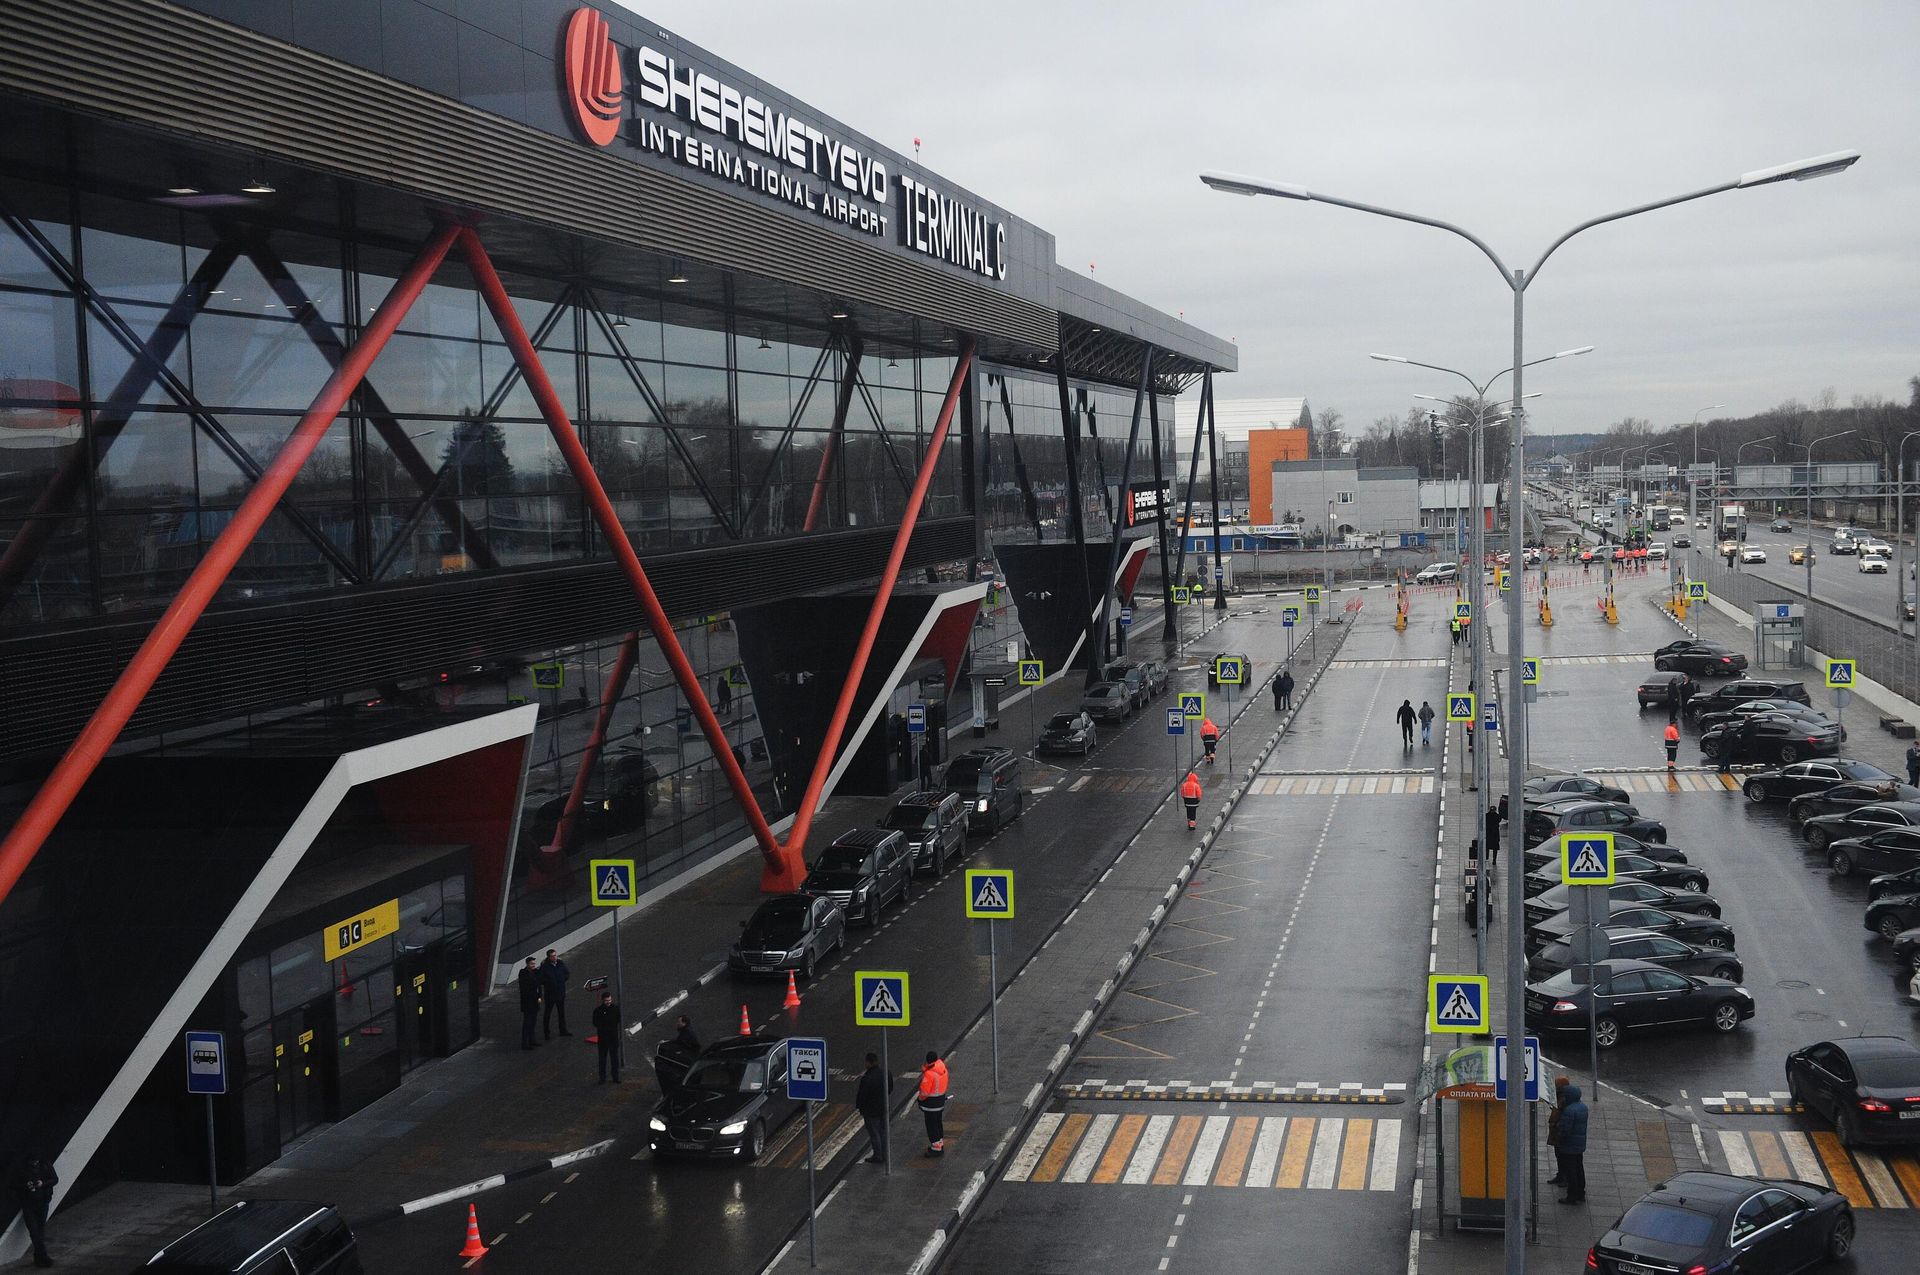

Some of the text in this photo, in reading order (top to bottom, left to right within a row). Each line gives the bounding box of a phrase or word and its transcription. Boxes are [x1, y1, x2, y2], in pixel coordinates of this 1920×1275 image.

[638, 46, 887, 203] SHEREMETYEVO
[641, 118, 888, 237] INTERNATIONAL AIRPORT
[901, 175, 1007, 281] TERMINAL C
